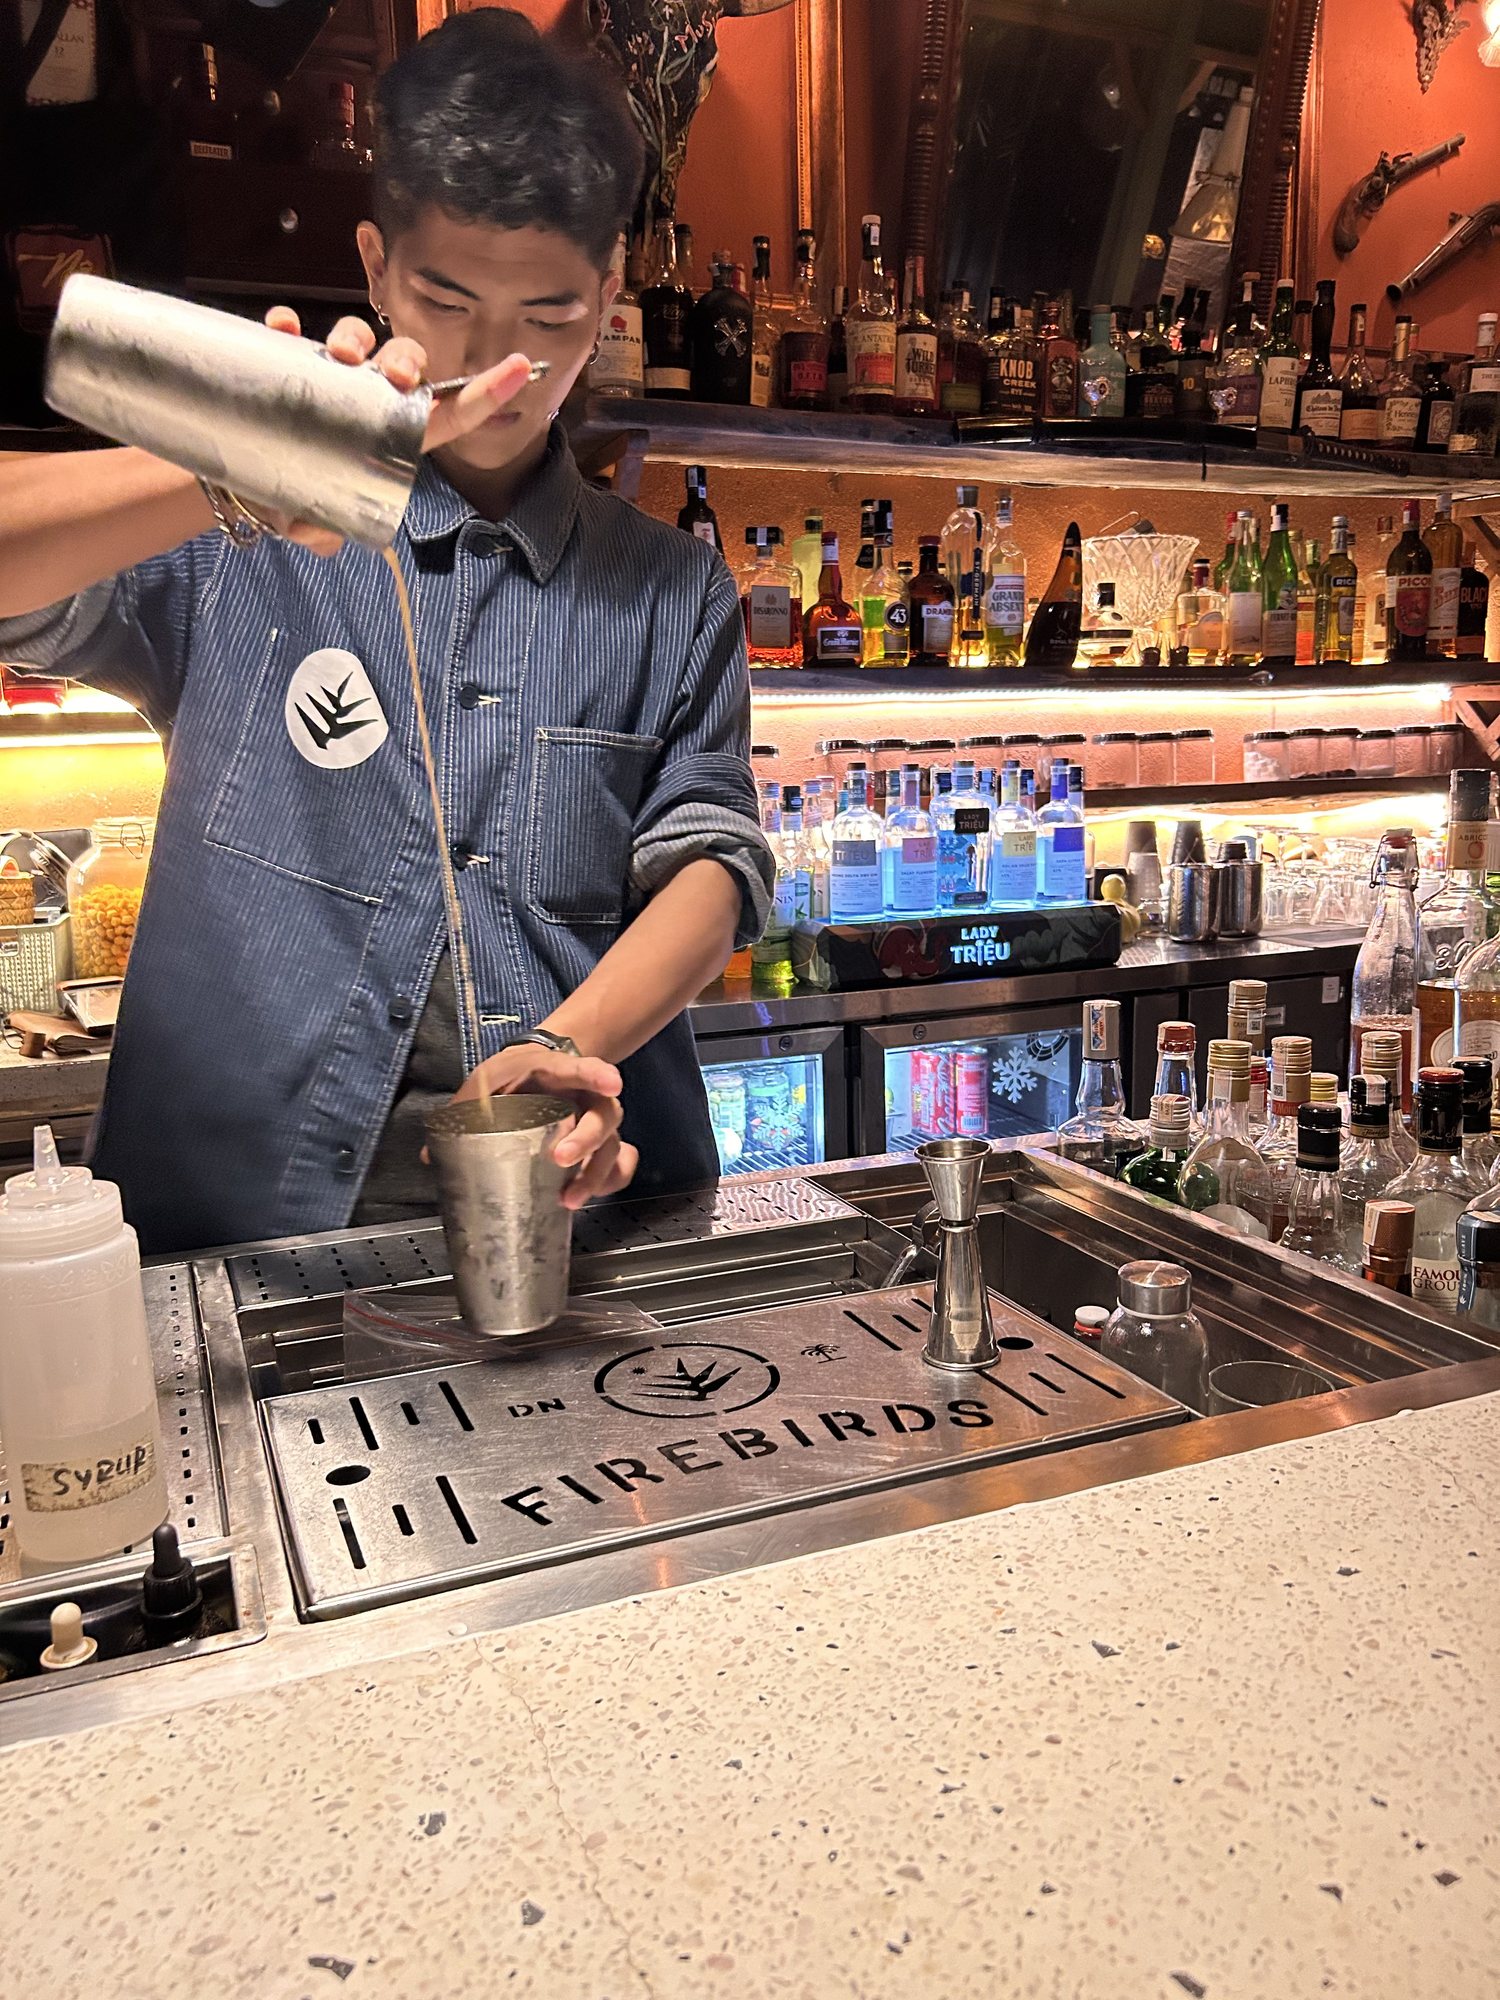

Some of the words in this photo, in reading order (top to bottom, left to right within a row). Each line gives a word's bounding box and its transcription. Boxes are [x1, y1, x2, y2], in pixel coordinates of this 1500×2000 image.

[1000, 358, 1034, 380] KNOB
[1003, 378, 1037, 389] CREEK
[753, 605, 788, 616] DISARONNO
[889, 608, 906, 624] 43
[961, 925, 999, 940] LADY
[950, 939, 1010, 966] TRIỆU
[508, 1398, 565, 1418] DN
[53, 1445, 147, 1496] SYRUP
[501, 1399, 995, 1526] FIREBIRDS
